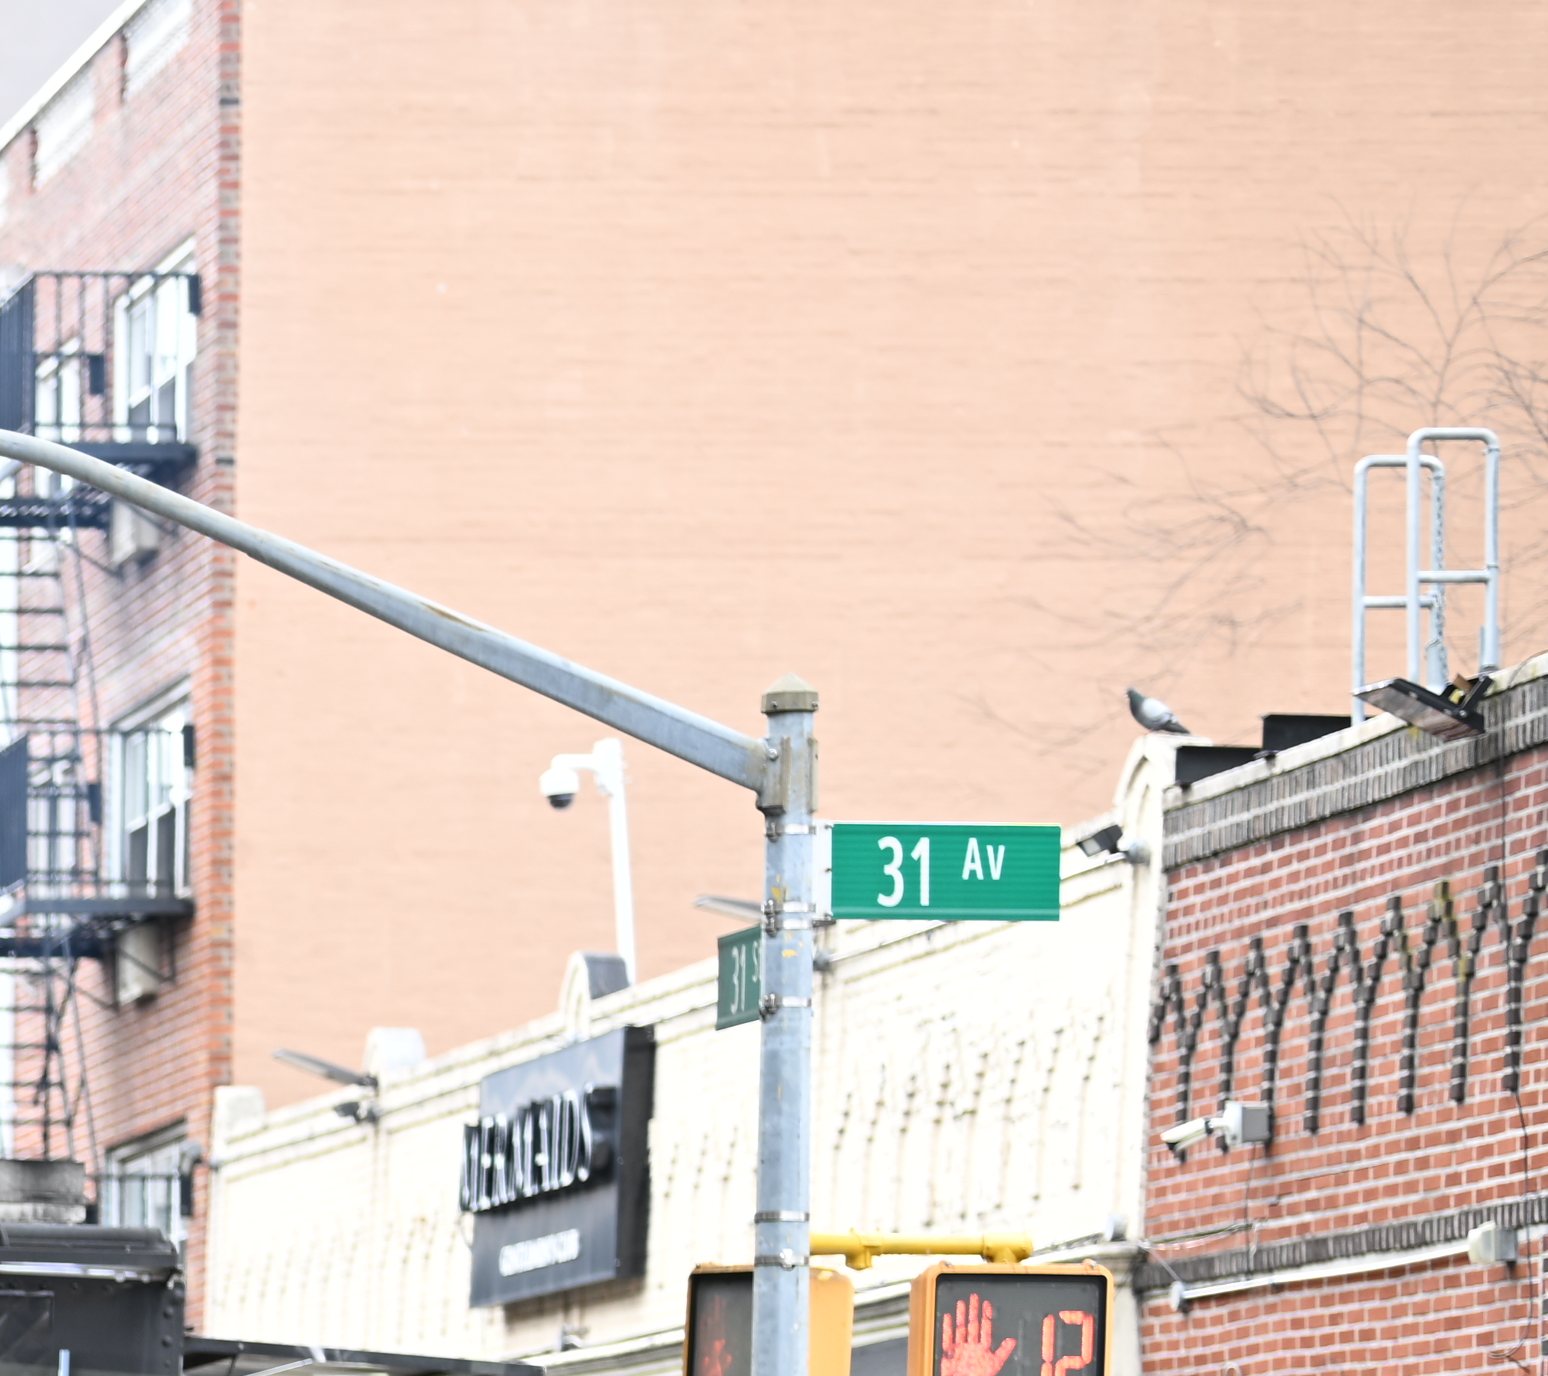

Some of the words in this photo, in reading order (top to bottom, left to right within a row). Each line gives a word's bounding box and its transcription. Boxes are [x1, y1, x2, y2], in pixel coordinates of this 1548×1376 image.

[876, 836, 930, 907] 31
[961, 837, 1006, 881] Av
[731, 943, 747, 1015] 31
